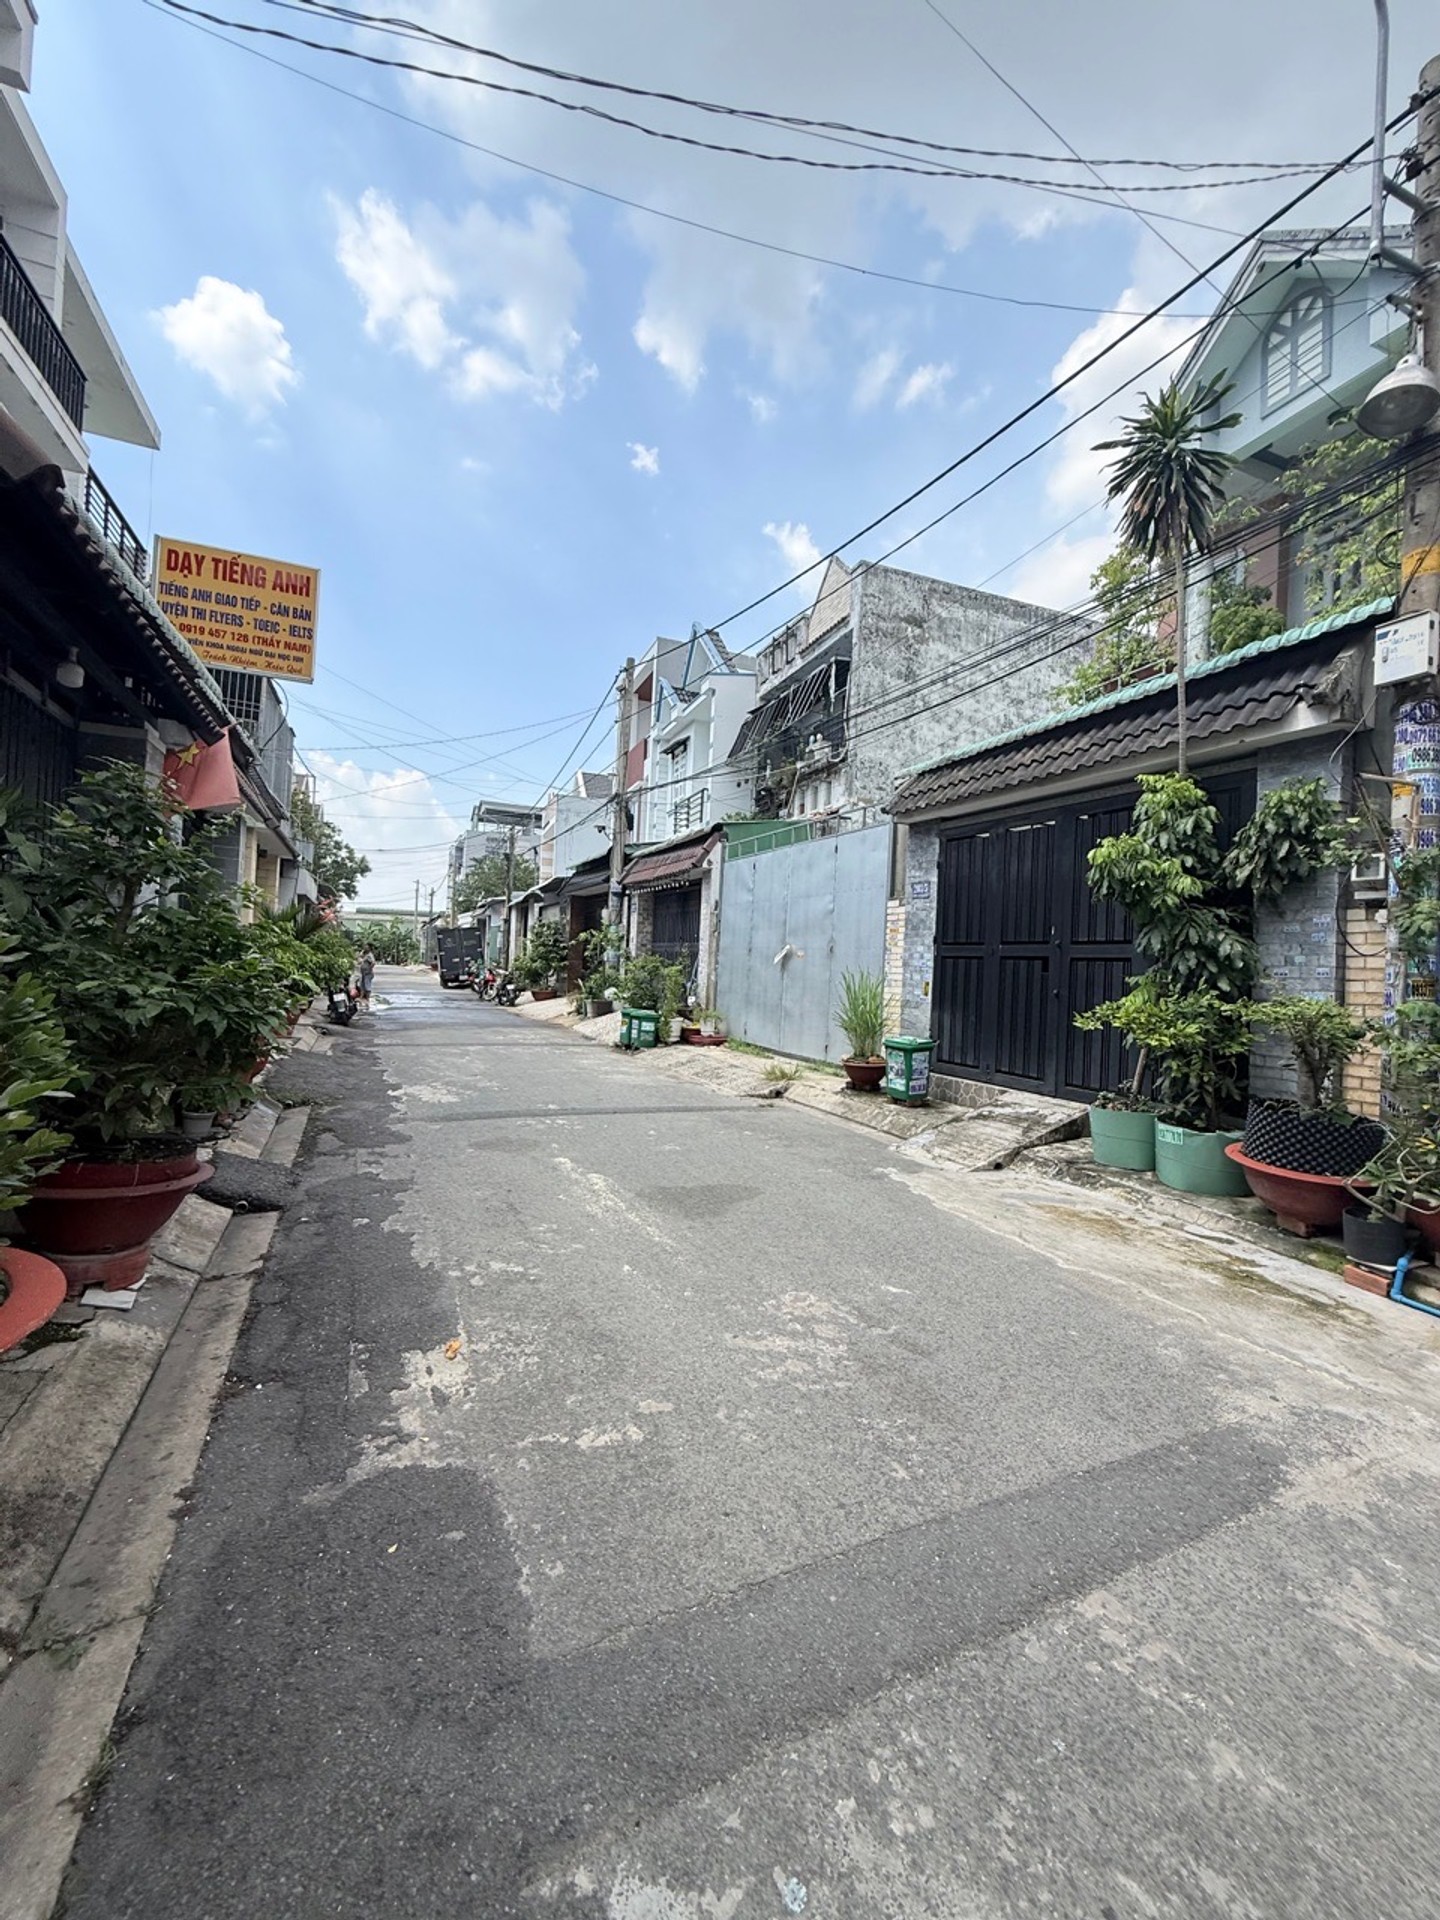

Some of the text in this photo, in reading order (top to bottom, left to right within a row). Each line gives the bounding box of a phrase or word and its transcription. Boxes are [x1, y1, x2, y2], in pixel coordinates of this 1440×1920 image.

[166, 548, 311, 598] DẠY TIẾNG ANH
[159, 580, 188, 598] TIẾNG
[191, 588, 213, 603] ANH
[215, 592, 238, 608] GIAO
[240, 595, 261, 612] TIẾP
[270, 601, 290, 618] CĂN
[292, 604, 312, 622] BẢN
[179, 623, 205, 635] 0919
[208, 628, 227, 639] 457
[191, 606, 206, 620] THI
[209, 610, 244, 627] FLYERS
[253, 618, 280, 634] TOEIC
[289, 624, 313, 640] IELTS
